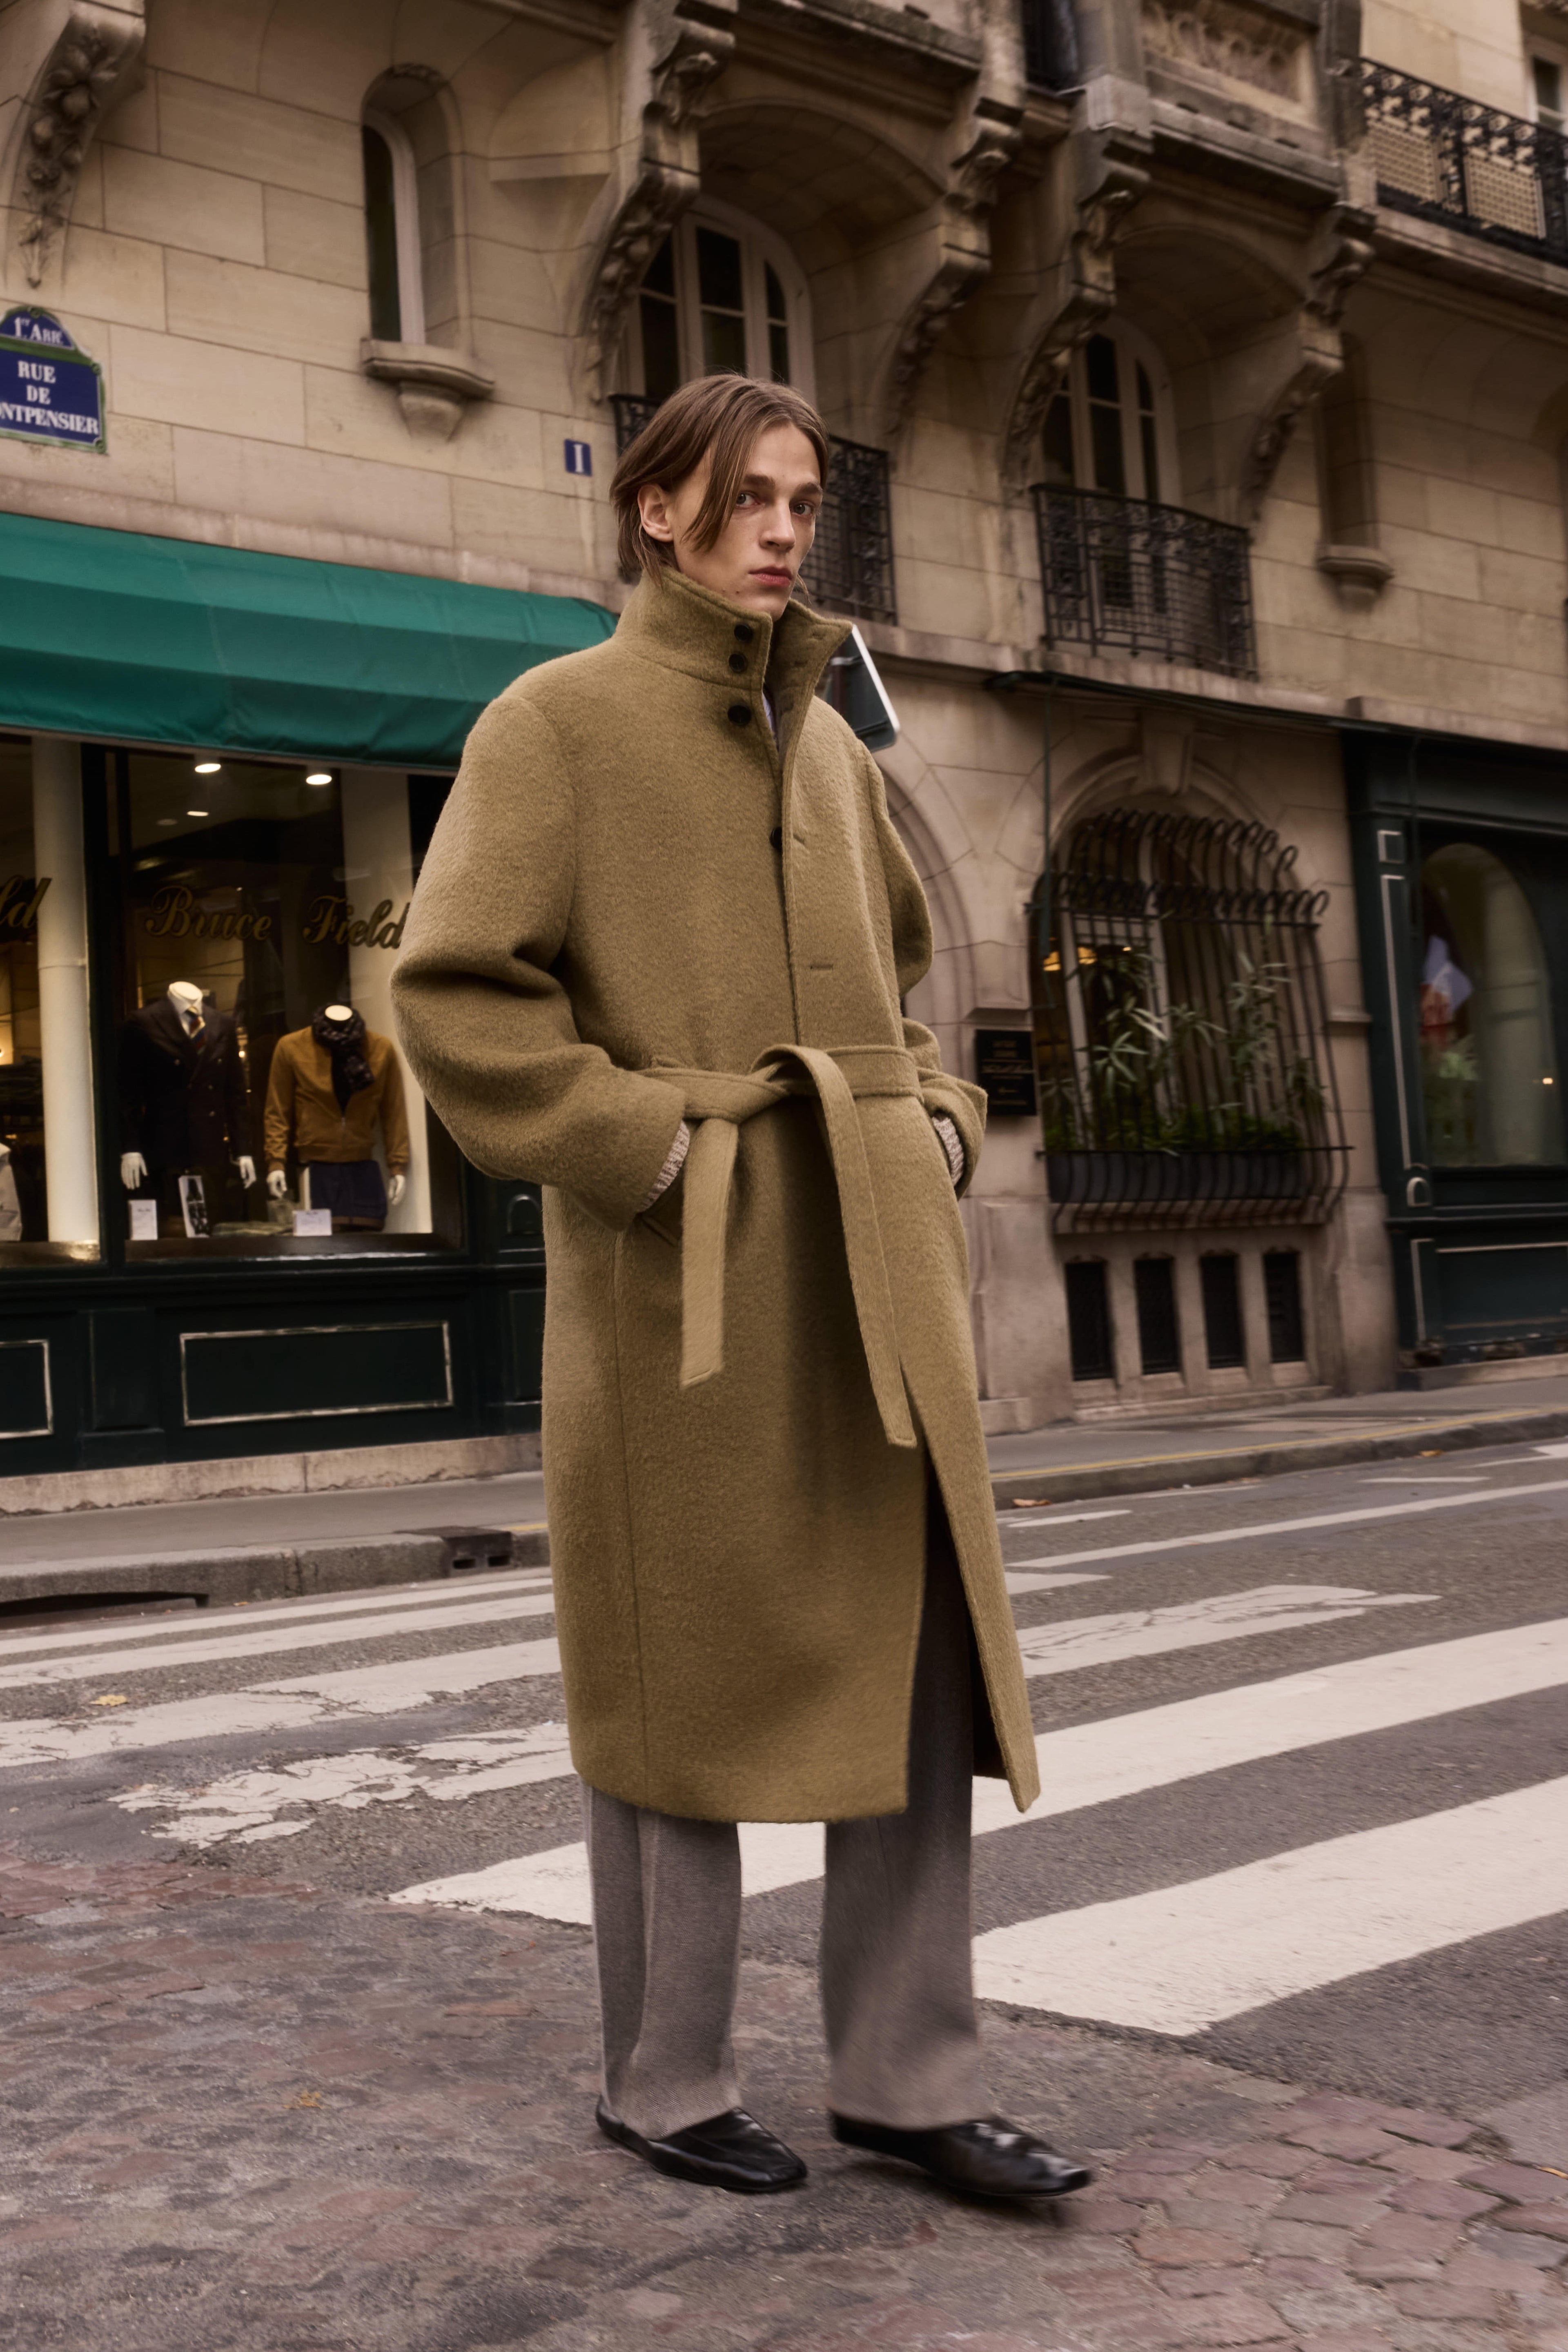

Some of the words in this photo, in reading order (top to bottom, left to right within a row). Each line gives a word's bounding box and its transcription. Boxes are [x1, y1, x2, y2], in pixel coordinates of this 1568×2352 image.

[18, 361, 56, 383] RUE
[27, 385, 51, 405] DE
[0, 401, 99, 435] NTPENSIER
[145, 885, 272, 940] Bruce
[302, 895, 410, 949] Field
